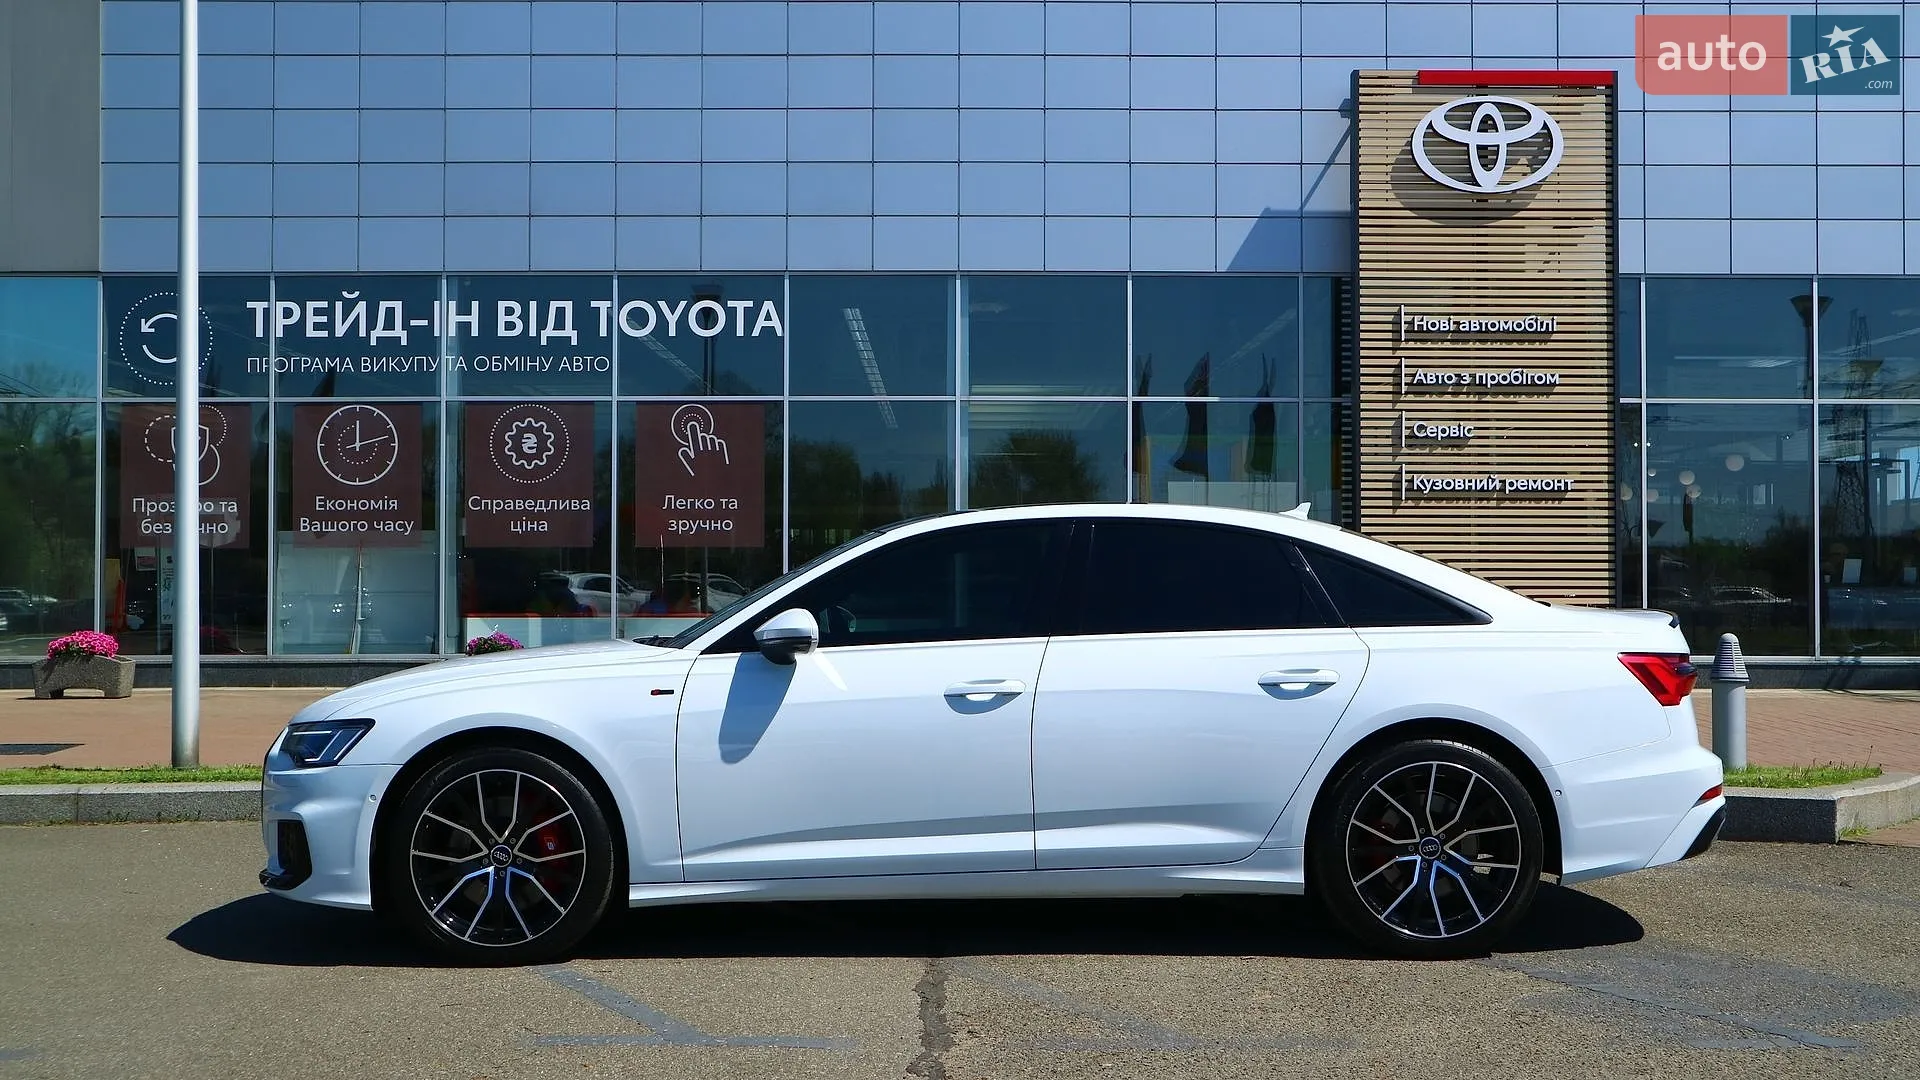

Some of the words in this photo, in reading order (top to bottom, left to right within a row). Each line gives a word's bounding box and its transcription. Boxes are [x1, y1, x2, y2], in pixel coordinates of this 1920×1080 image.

[246, 290, 479, 346] ТРЕЙД-ІН
[497, 300, 578, 346] ВІД
[590, 300, 784, 337] TOYOTA
[1413, 315, 1455, 332] Нові
[1460, 315, 1558, 332] автомобілі
[247, 356, 354, 373] ПРОГРАМА
[361, 356, 440, 372] ВИКУПУ
[445, 355, 468, 372] ТА
[473, 355, 553, 372] ОБМІНУ
[558, 355, 610, 372] АВТО
[1413, 369, 1456, 385] Авто
[1460, 373, 1470, 385] з
[1476, 369, 1560, 387] пробігом
[1413, 422, 1474, 441] Сервіс
[1413, 474, 1500, 494] Кузовний
[1505, 479, 1574, 494] ремонт
[219, 501, 238, 513] та
[315, 496, 398, 511] Економія
[468, 496, 591, 515] Справедлива
[662, 495, 715, 510] Легко
[719, 499, 738, 510] та
[300, 518, 368, 533] Вашого
[373, 520, 414, 536] часу
[510, 517, 549, 533] ціна
[667, 520, 733, 535] зручно
